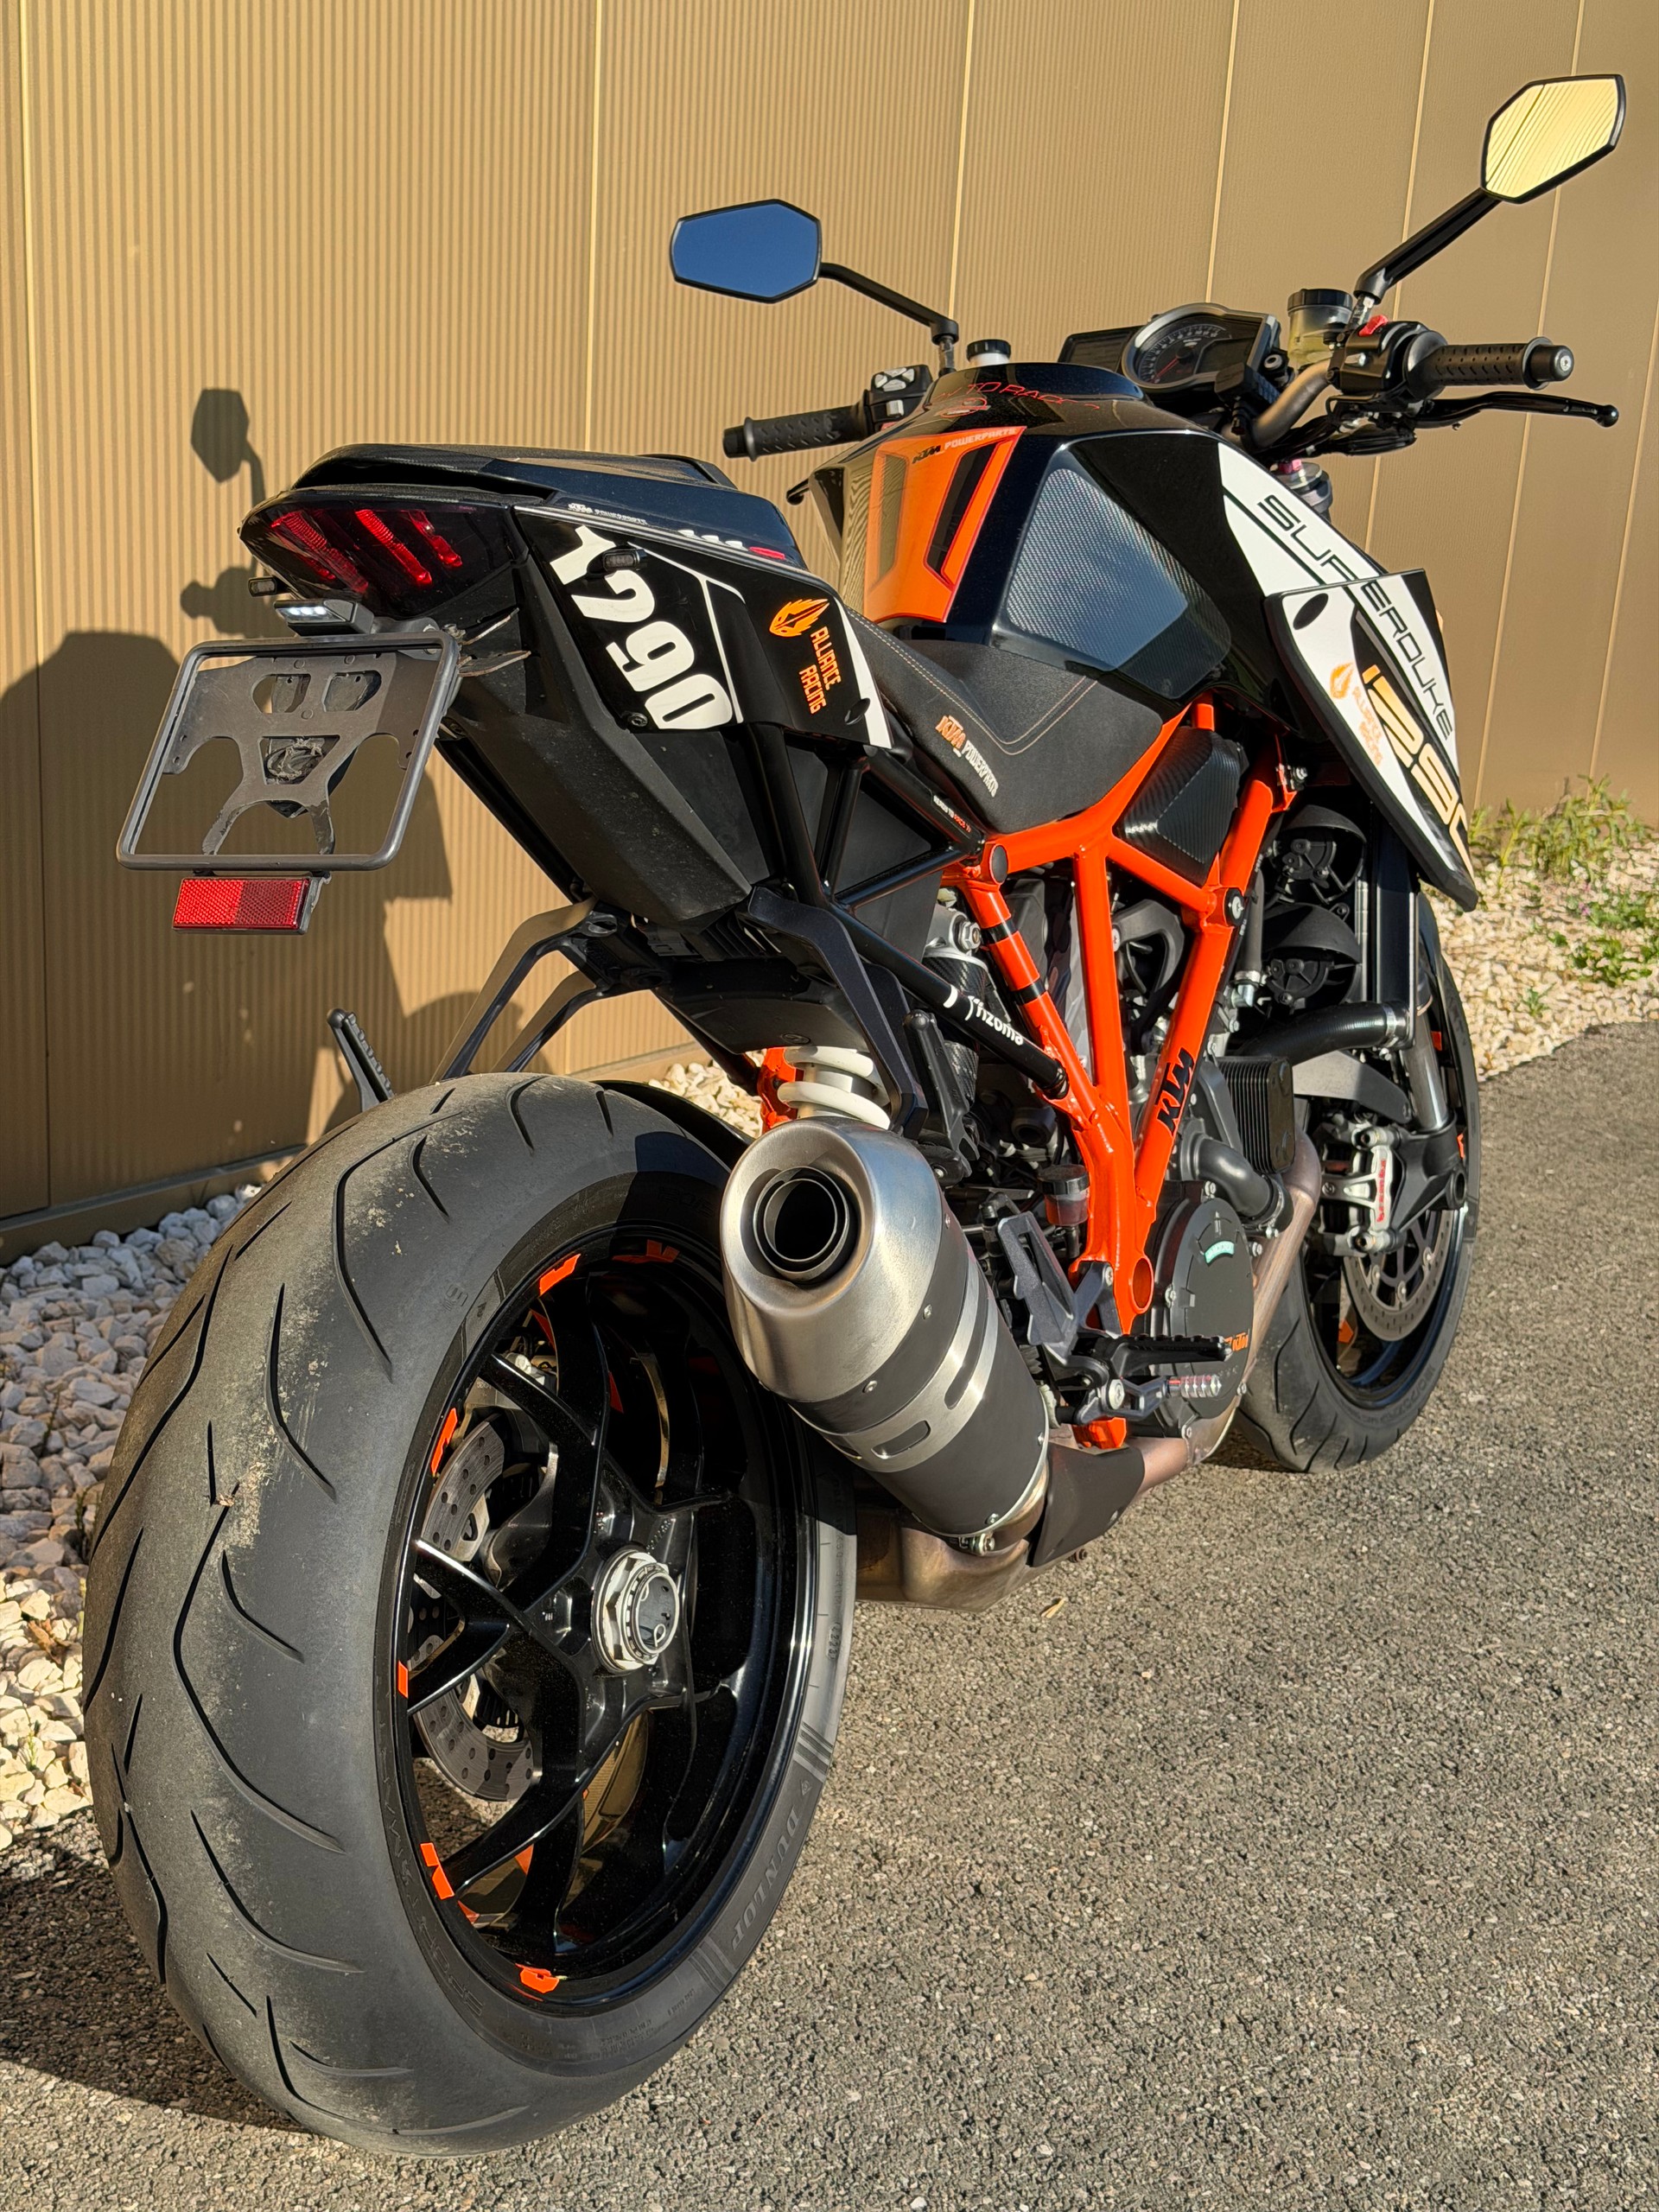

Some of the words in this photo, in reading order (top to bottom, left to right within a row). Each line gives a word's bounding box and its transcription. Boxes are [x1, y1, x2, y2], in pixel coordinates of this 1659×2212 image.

[912, 445, 941, 464] KTM
[944, 428, 1016, 449] POWERPARTS
[550, 525, 733, 729] 1290
[1257, 494, 1452, 740] SUPERDUKE
[799, 664, 826, 714] RACING
[810, 626, 841, 690] ALLIANCE
[935, 715, 966, 748] KTM
[1154, 1047, 1195, 1136] KTM
[730, 1804, 800, 1952] DUNLOP
